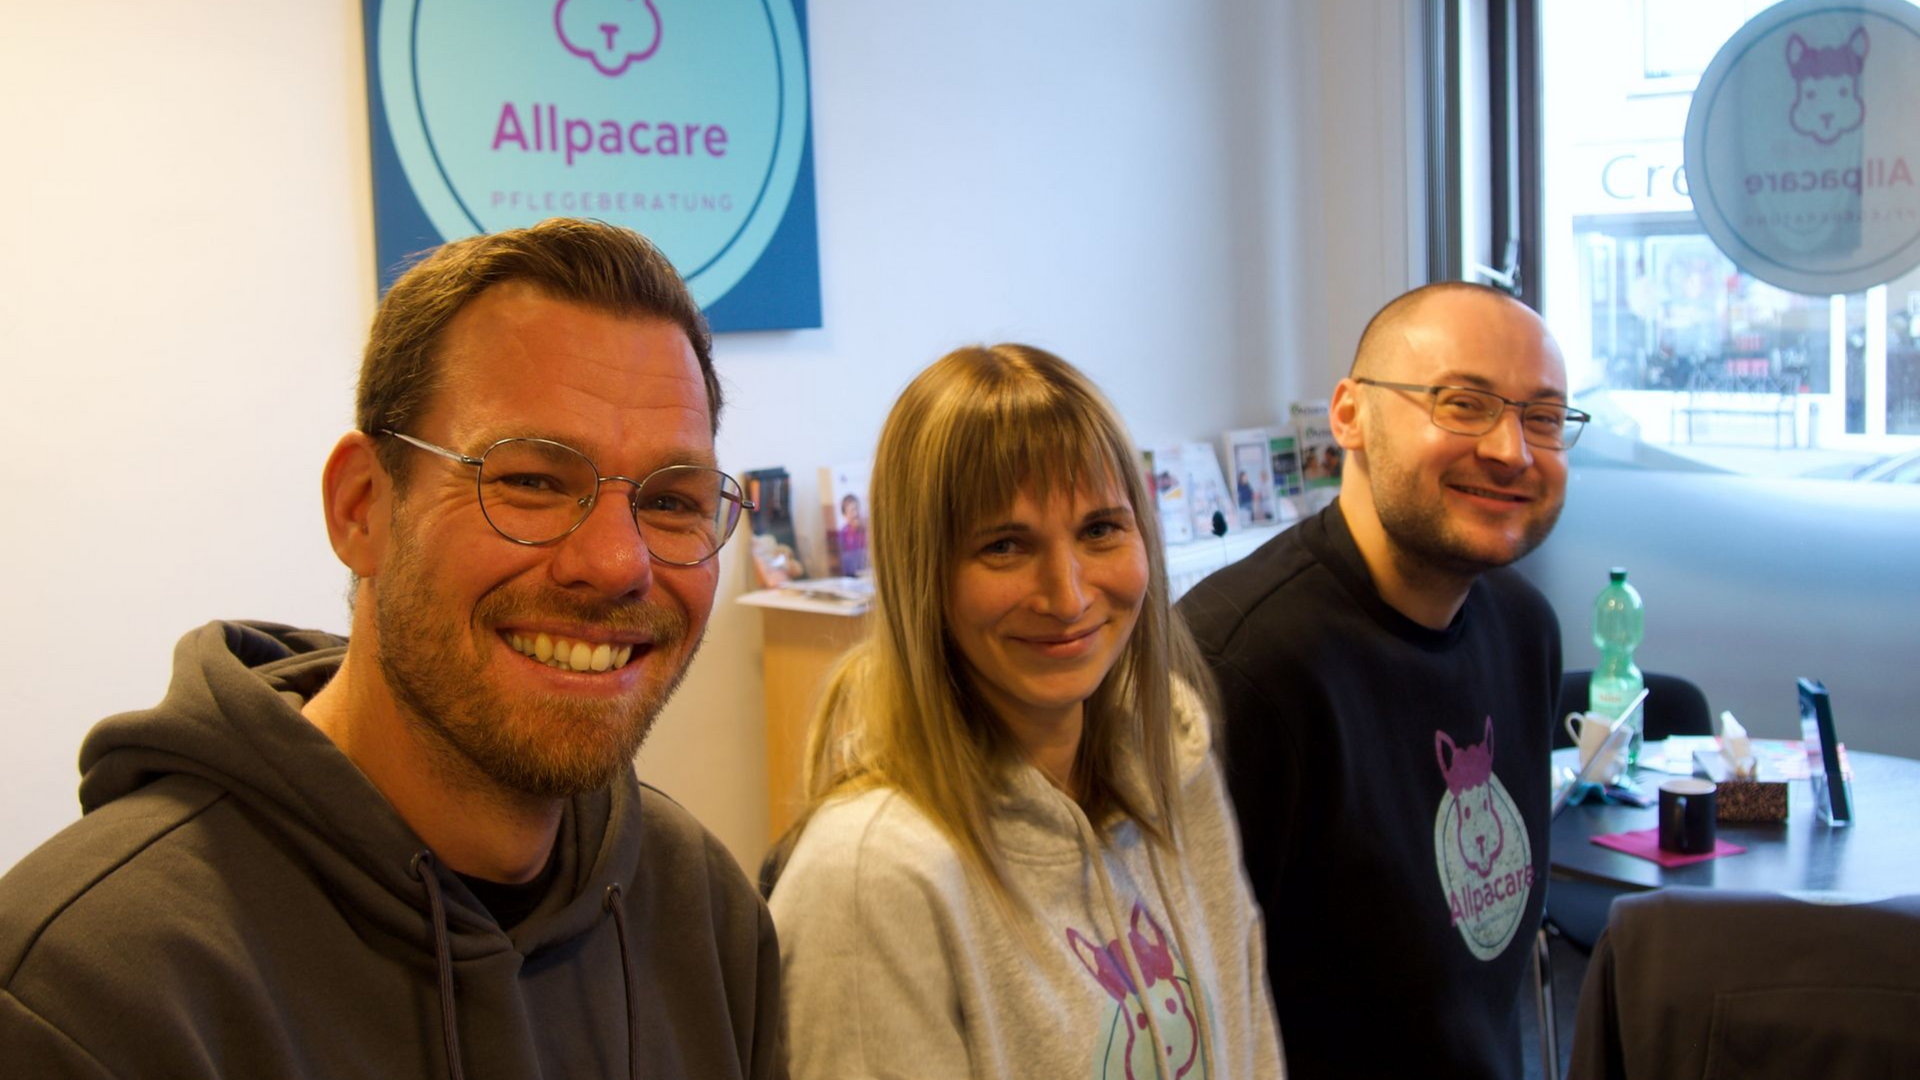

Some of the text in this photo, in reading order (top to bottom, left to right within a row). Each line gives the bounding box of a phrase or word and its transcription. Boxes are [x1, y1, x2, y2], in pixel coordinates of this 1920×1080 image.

[492, 102, 729, 166] Allpacare
[491, 191, 734, 212] PFLEGEBERATUNG
[1450, 863, 1535, 928] Allpacare
